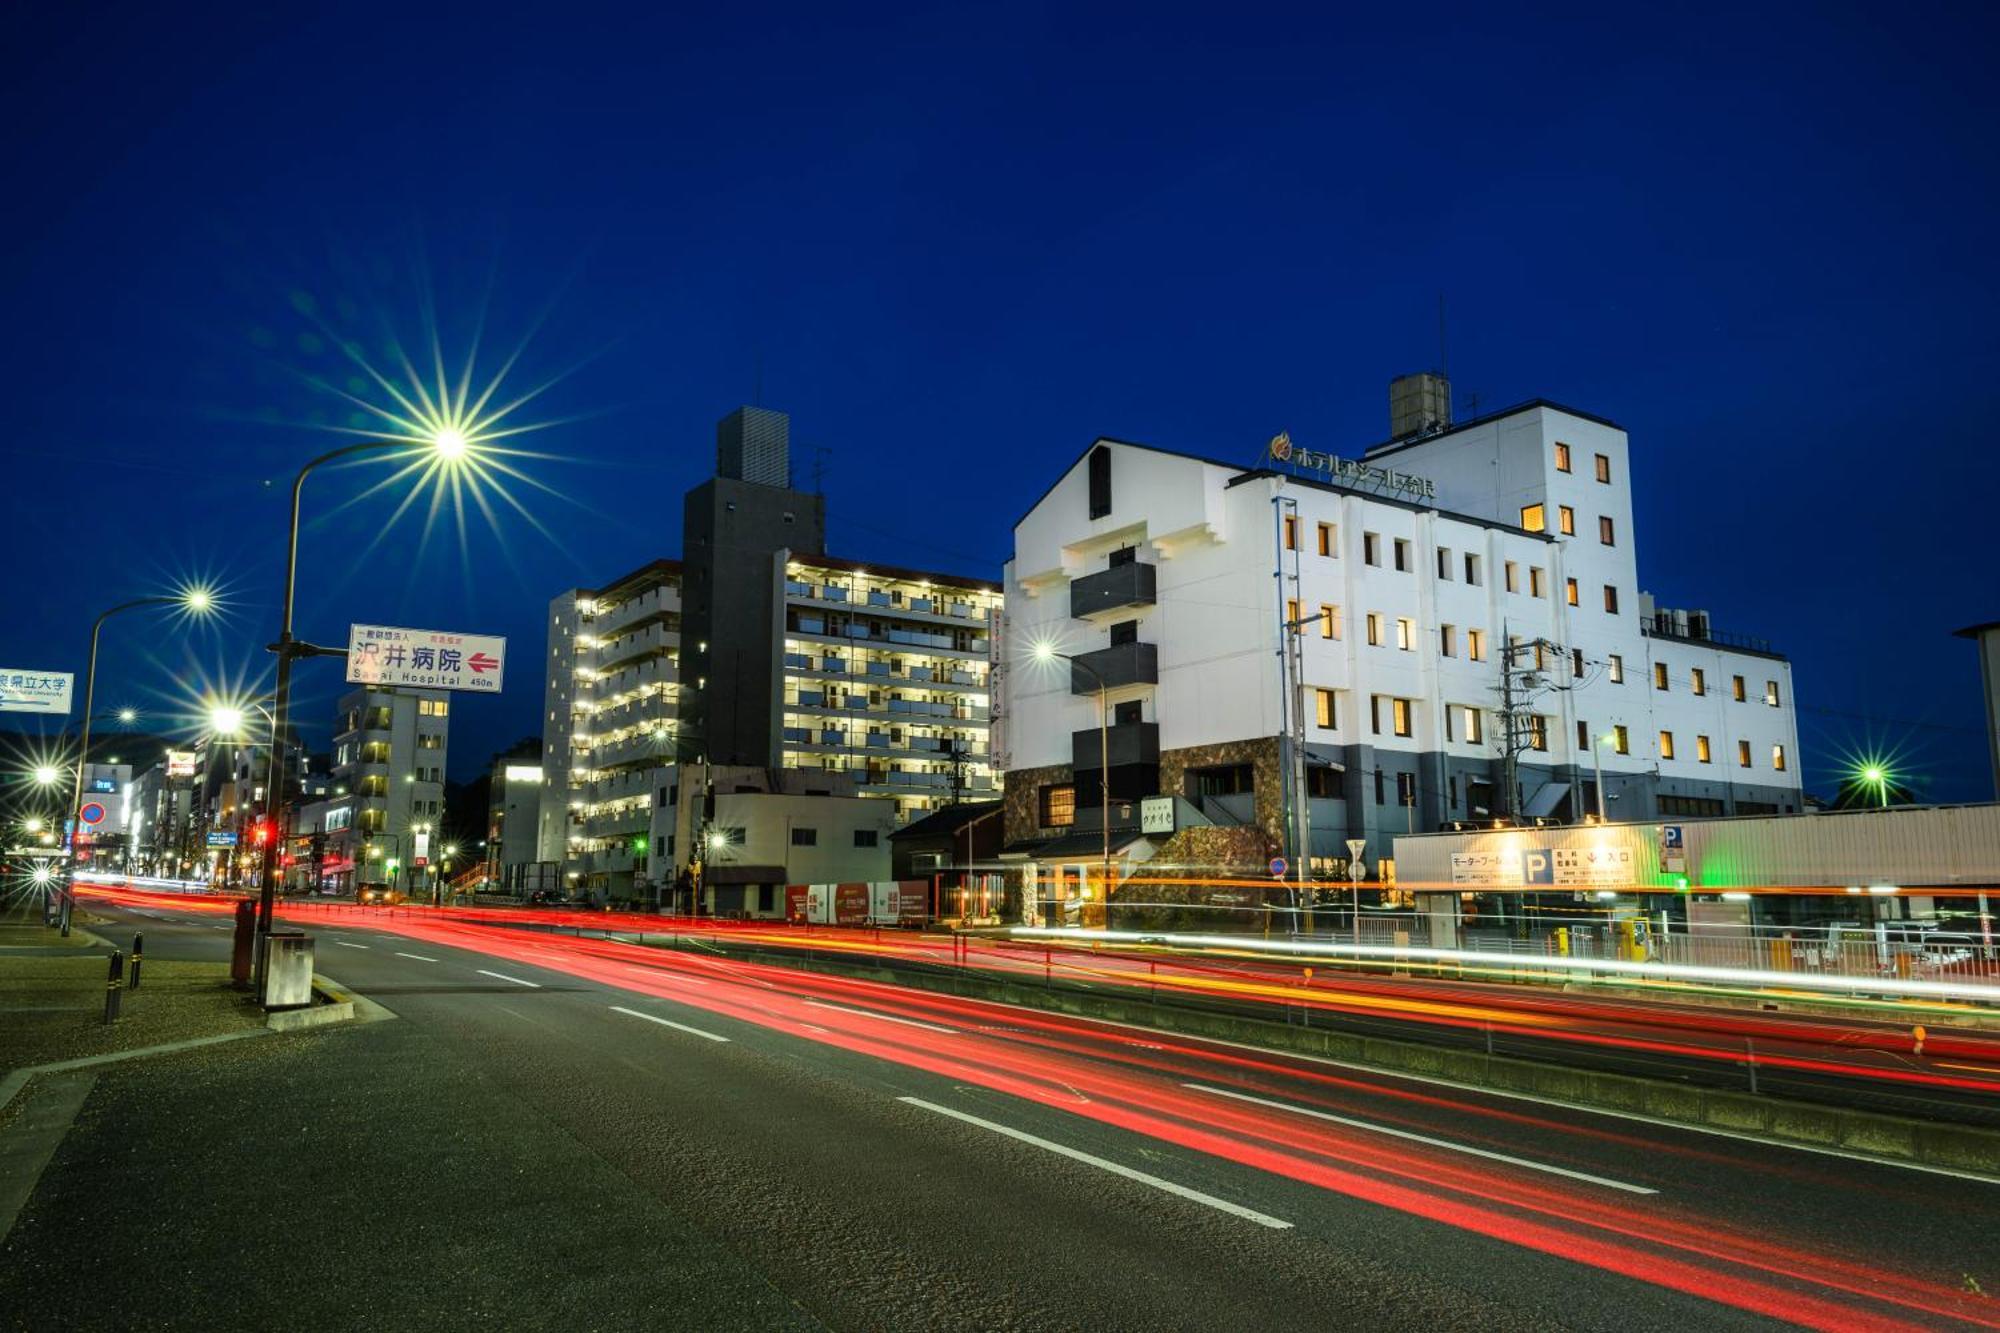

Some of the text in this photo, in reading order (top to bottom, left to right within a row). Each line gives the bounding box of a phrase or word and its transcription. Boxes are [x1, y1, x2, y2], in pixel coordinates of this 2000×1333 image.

[354, 641, 462, 672] 沢井病院
[401, 672, 461, 686] Hospital
[470, 677, 493, 687] 450m
[1664, 828, 1677, 847] P
[1526, 854, 1546, 882] P
